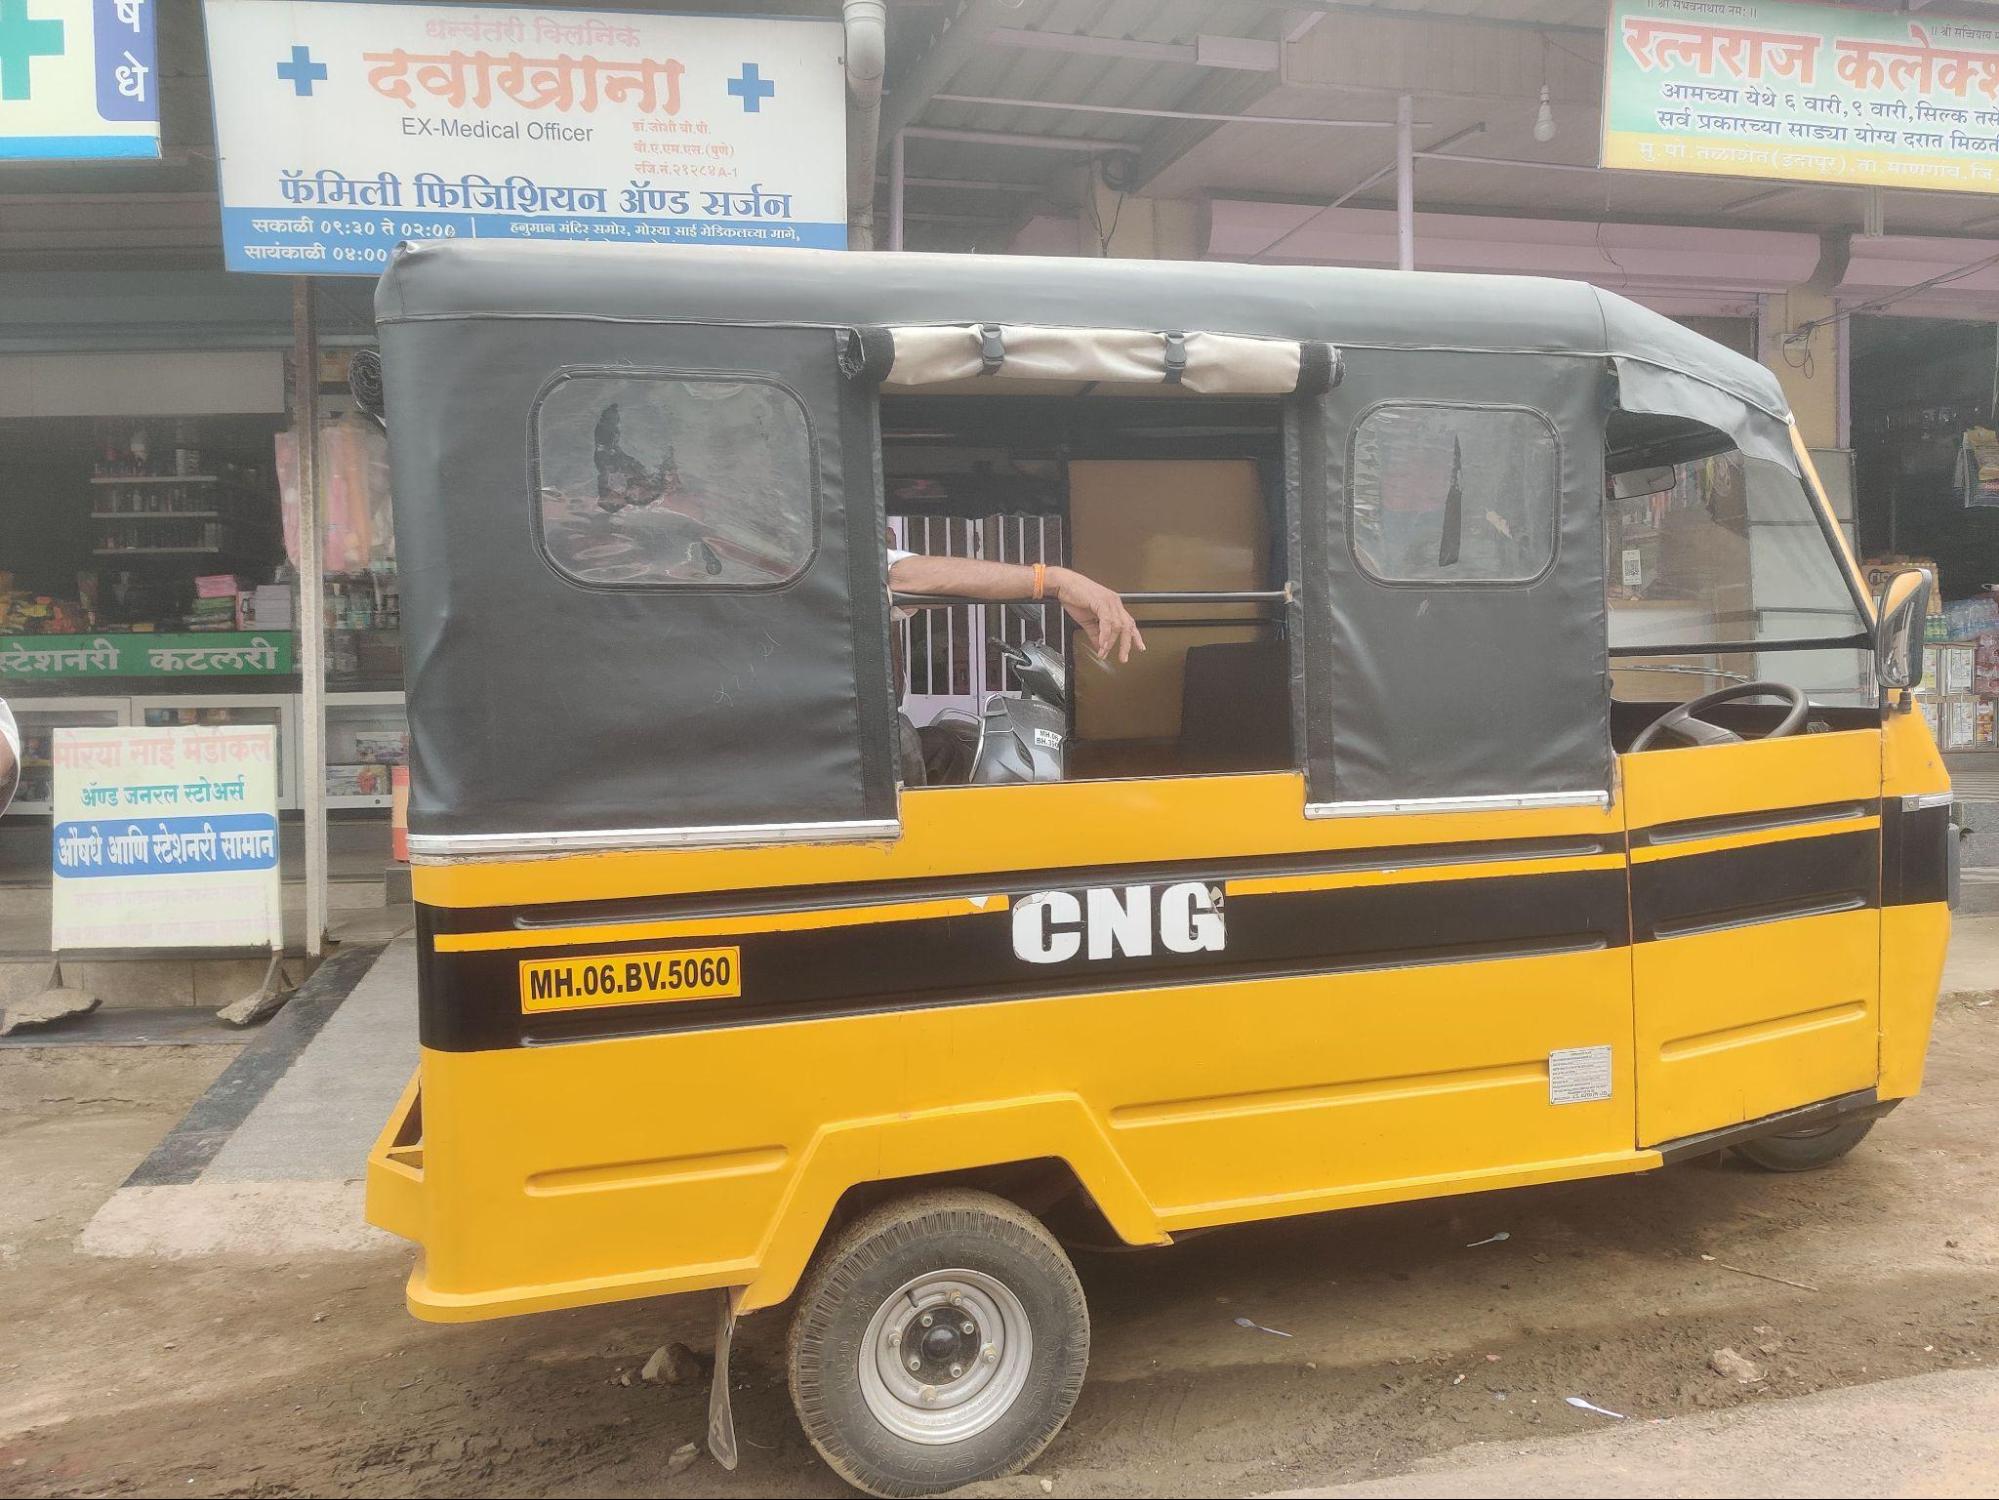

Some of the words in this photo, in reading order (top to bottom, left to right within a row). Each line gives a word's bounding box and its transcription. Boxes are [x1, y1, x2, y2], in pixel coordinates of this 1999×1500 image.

[425, 15, 525, 43] धन्वंतरी
[534, 16, 641, 47] क्लिनिक
[1624, 18, 1821, 84] रत्नराज
[363, 47, 685, 116] दवाखाना
[1663, 82, 1738, 104] आमच्या
[1746, 85, 1776, 108] येथे
[1785, 94, 1796, 112] ६
[401, 117, 520, 139] EX-Medical
[527, 121, 594, 142] Officer
[1657, 106, 1691, 127] सर्व
[1697, 114, 1781, 136] प्रकारच्या
[1788, 120, 1848, 142] साड्या
[1854, 122, 1897, 145] योग्य
[1903, 131, 1943, 149] दरात
[279, 169, 403, 208] फॅमिली
[414, 173, 607, 215] फिजिशियन
[700, 183, 793, 219] सर्जन
[252, 215, 313, 233] सकाळी
[320, 220, 375, 236] ०९:३०
[380, 218, 395, 236] ते
[510, 222, 555, 236] हनुमान
[559, 222, 595, 236] मंदिर
[596, 223, 631, 236] समोर,
[675, 222, 698, 237] साई
[701, 223, 767, 240] मेडिकलच्या
[244, 241, 326, 260] सायंकाळी
[148, 637, 279, 671] कटलरी
[123, 784, 179, 806] जनरल
[184, 774, 245, 803] स्टोअर्स
[58, 825, 103, 867] औषधे
[107, 824, 149, 866] आणि
[152, 822, 217, 864] स्टेशनरी
[220, 829, 275, 859] सामान
[1012, 882, 1227, 964] CNG
[530, 956, 731, 1000] MH.06.BV.5060
